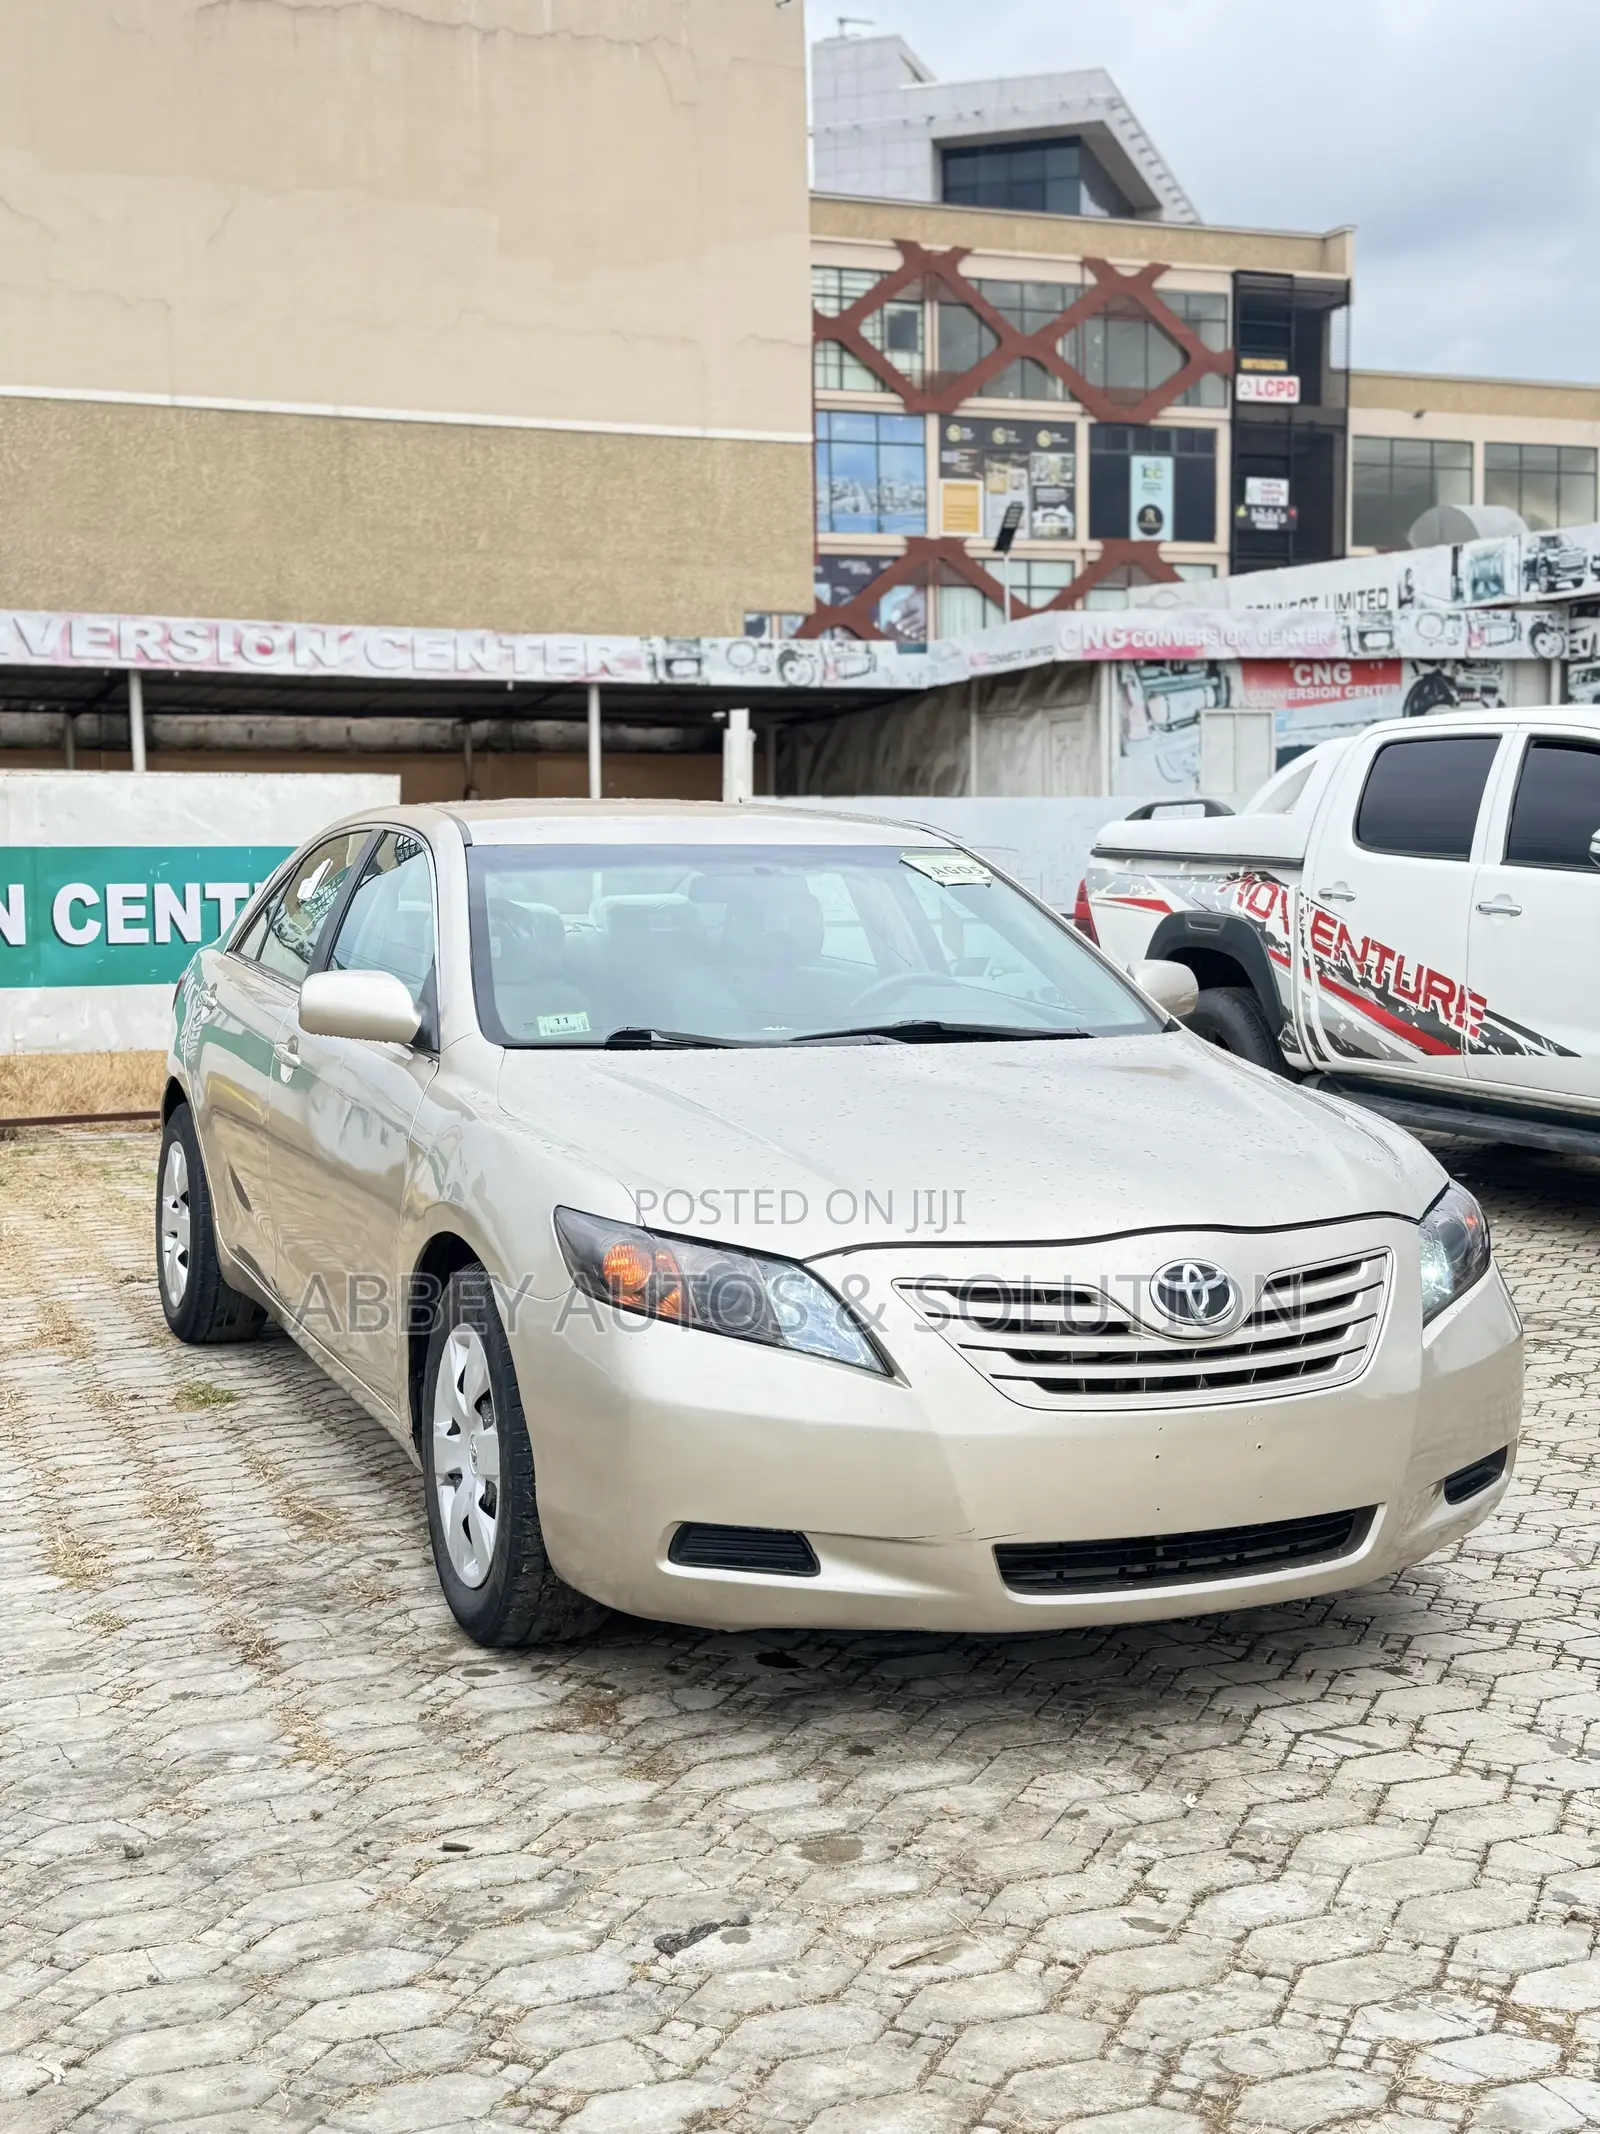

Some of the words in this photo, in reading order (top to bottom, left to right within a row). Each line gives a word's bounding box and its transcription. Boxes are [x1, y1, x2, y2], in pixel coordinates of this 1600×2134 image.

[1255, 380, 1297, 397] LCPD
[0, 617, 342, 667] VERSION
[363, 632, 624, 677] CENTER
[1060, 624, 1128, 652] CNG
[1131, 629, 1251, 649] CONVERSION
[1258, 628, 1335, 647] CENTER
[1294, 662, 1352, 686] CNG
[53, 882, 264, 946] CENT
